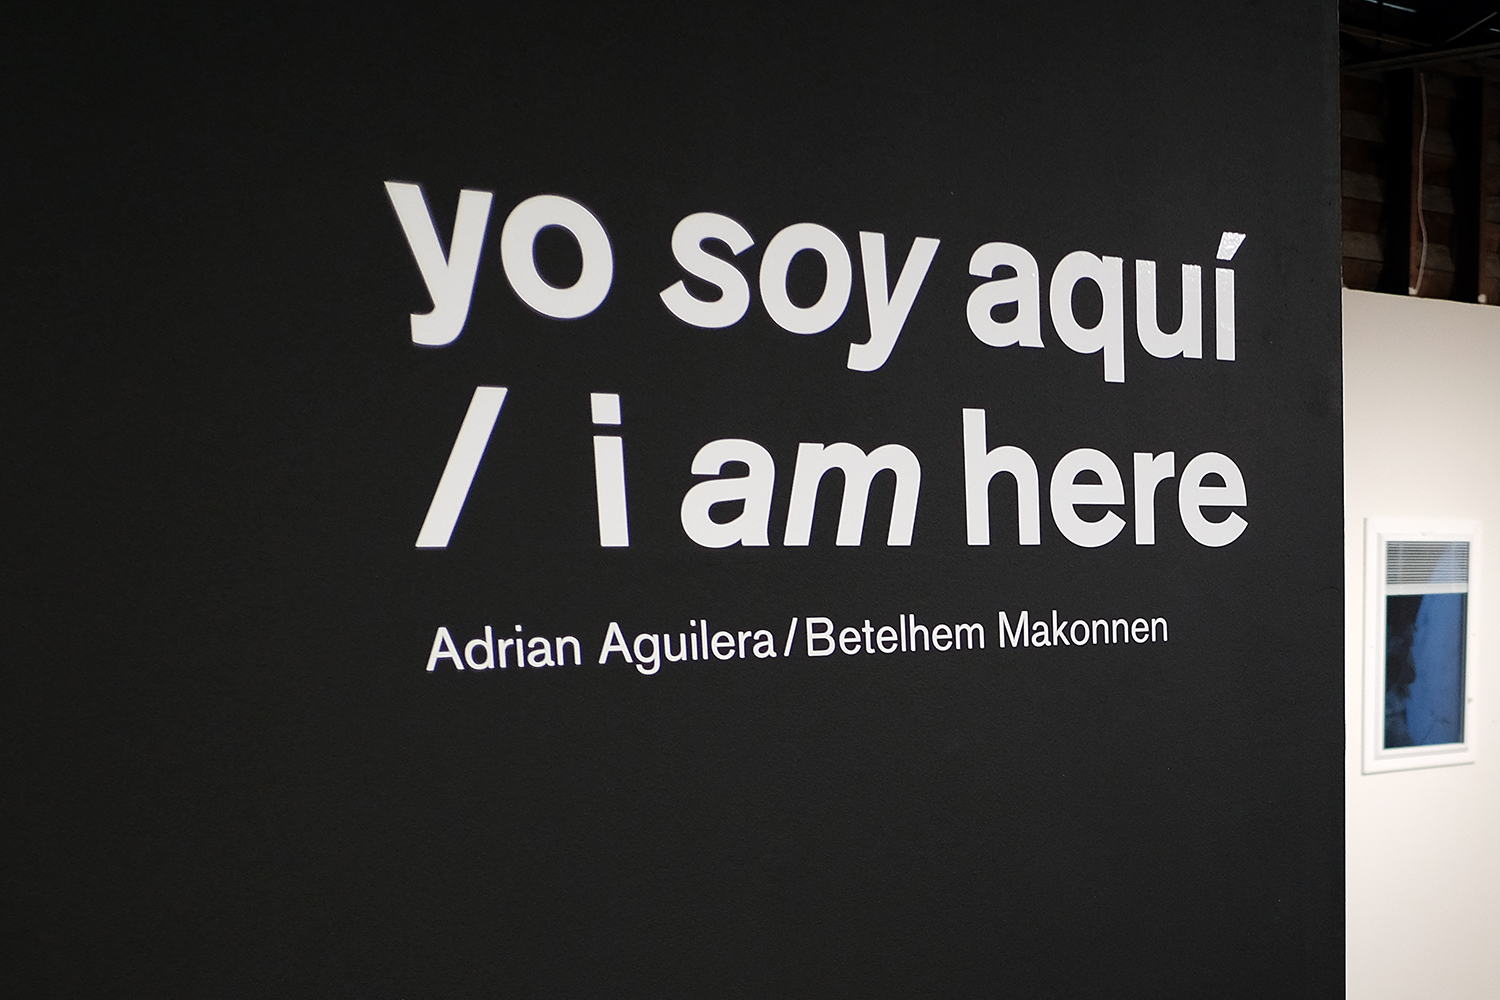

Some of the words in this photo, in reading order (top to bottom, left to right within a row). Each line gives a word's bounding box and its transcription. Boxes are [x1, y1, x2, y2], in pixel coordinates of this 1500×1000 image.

[384, 181, 613, 346] yo
[660, 212, 940, 372] soy
[967, 231, 1247, 384] aquí
[415, 386, 508, 548] /
[591, 393, 630, 548] i
[681, 438, 922, 549] am
[963, 408, 1249, 548] here
[425, 625, 582, 672] Adrian
[998, 610, 1168, 648] Makonnen
